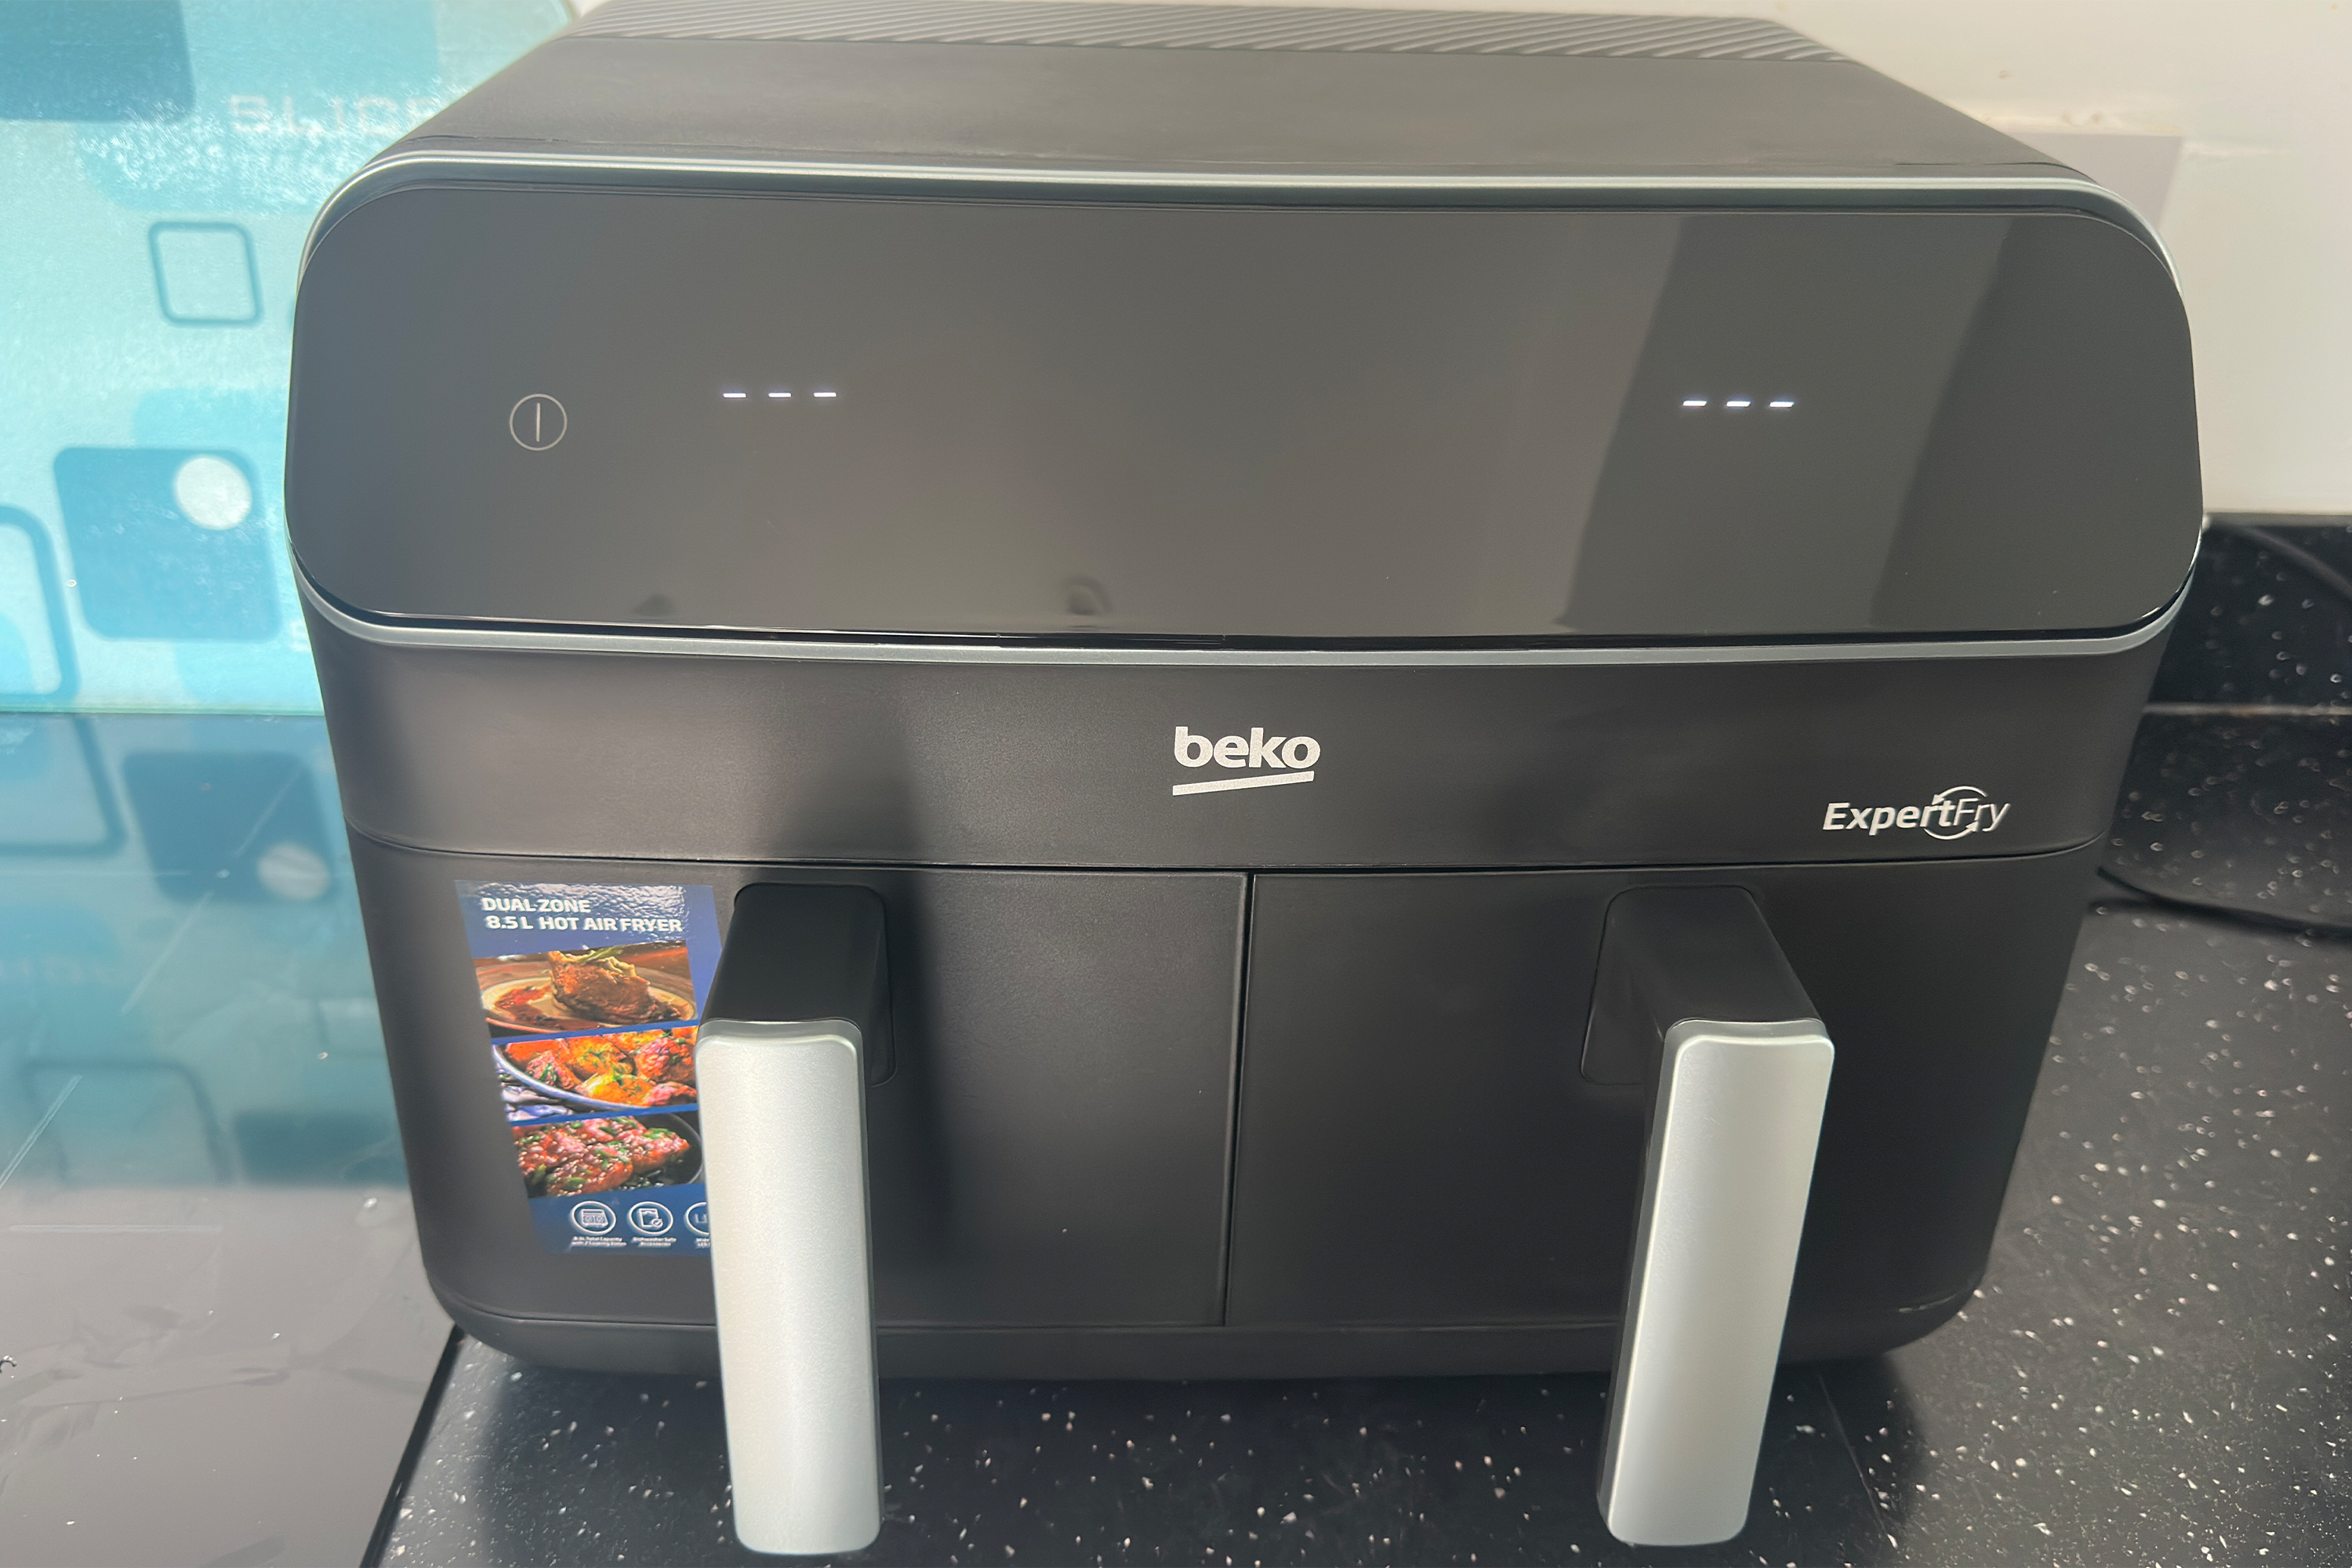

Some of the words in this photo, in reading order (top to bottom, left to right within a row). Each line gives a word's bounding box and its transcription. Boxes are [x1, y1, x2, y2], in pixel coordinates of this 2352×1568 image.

[1174, 726, 1321, 769] beko
[1822, 797, 2011, 837] ExpertFry
[481, 897, 536, 912] DUAL
[537, 898, 591, 913] ZONE
[538, 916, 579, 931] HOT
[583, 917, 618, 931] AIR
[619, 918, 684, 932] FRYER
